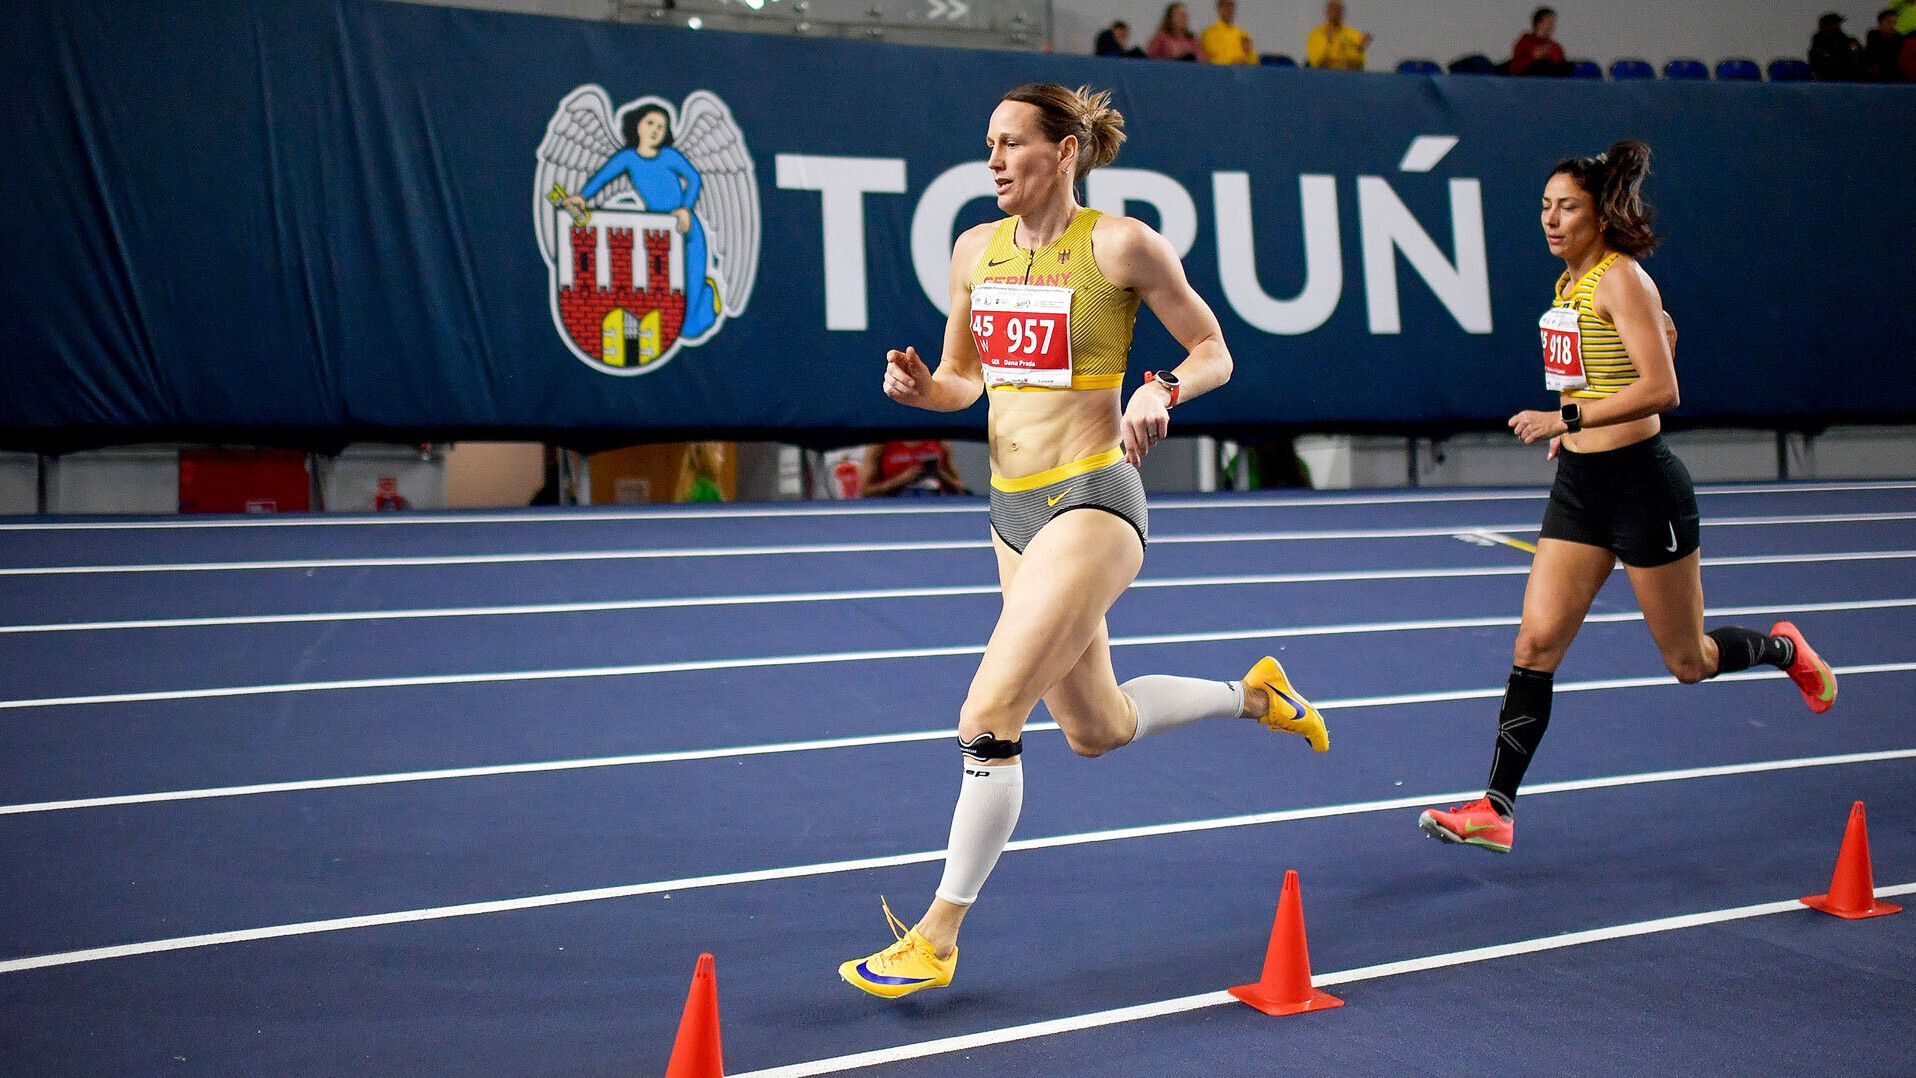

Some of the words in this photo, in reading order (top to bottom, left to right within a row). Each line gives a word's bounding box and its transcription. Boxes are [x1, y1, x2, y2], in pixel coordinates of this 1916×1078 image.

[972, 315, 994, 337] 45
[1006, 317, 1055, 354] 957
[979, 339, 989, 353] W
[1549, 333, 1572, 365] 918
[963, 768, 990, 777] ep
